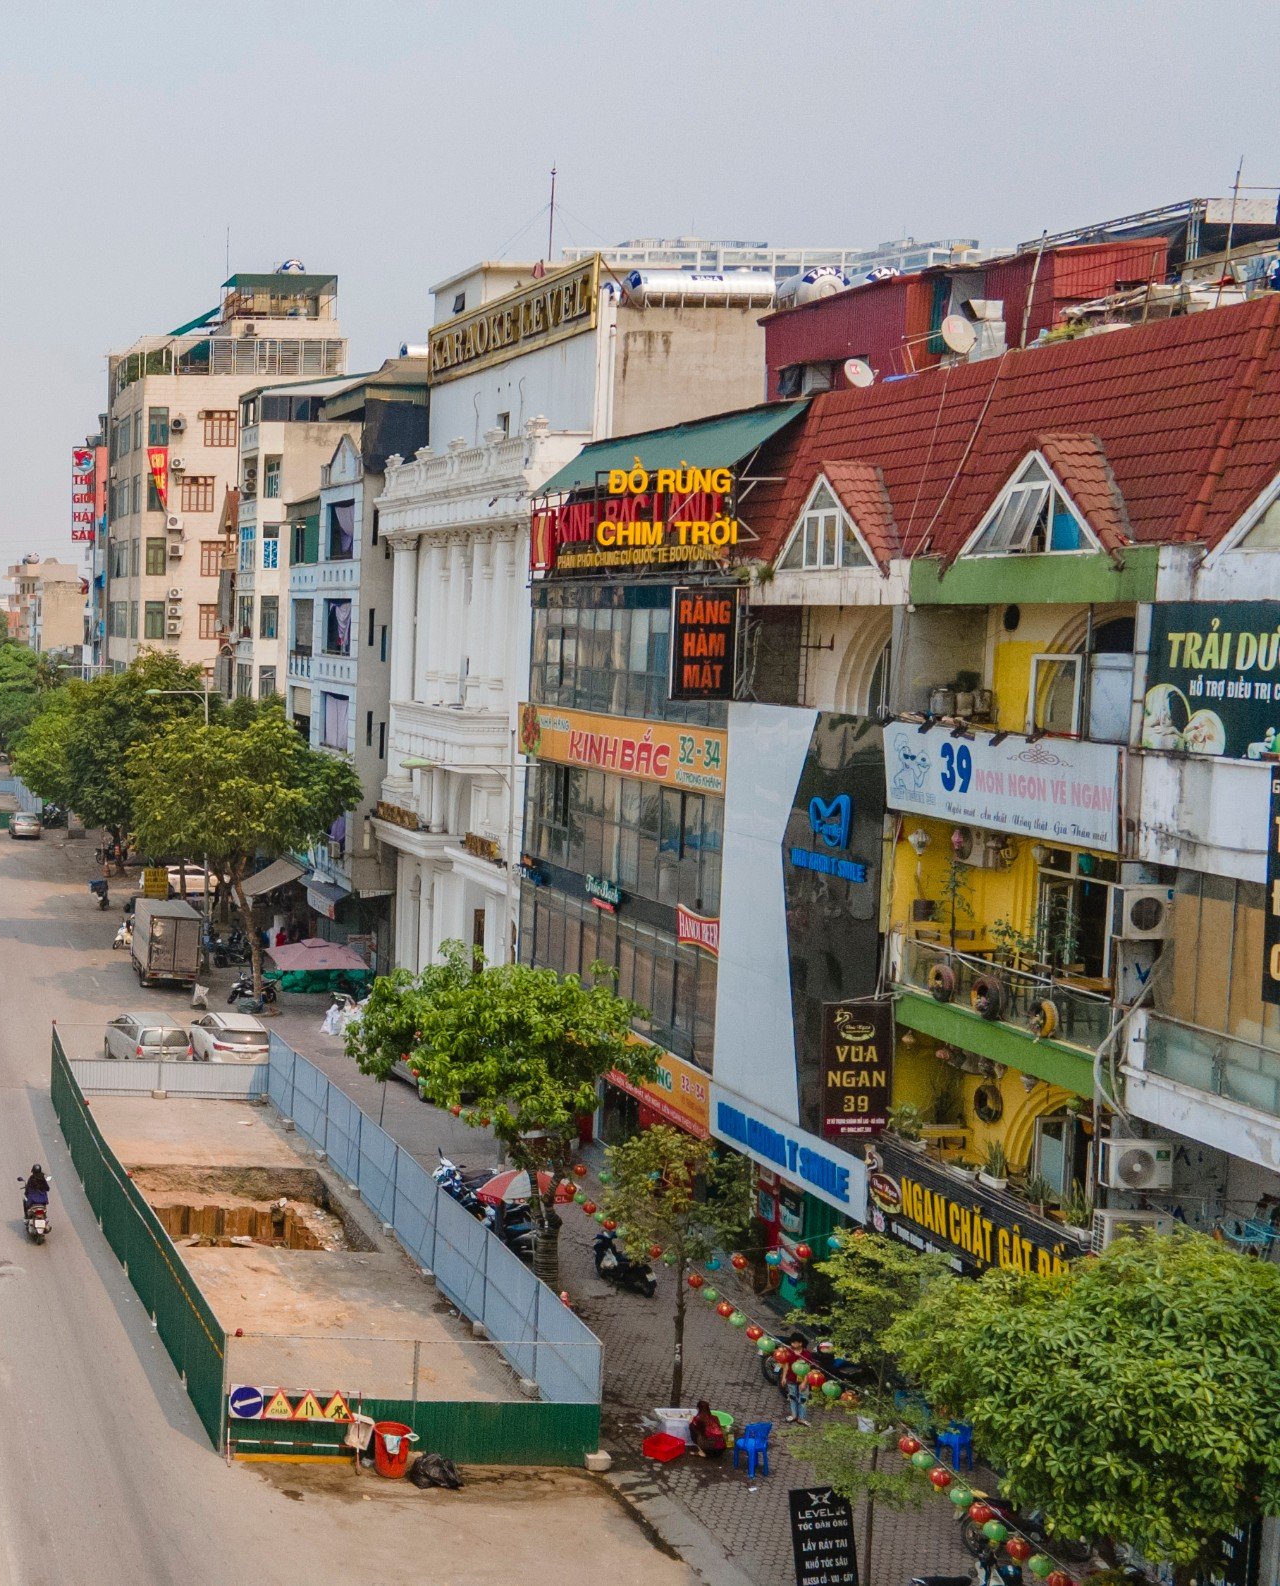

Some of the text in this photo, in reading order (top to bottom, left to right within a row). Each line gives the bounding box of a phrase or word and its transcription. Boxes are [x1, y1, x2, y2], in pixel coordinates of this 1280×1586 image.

[431, 274, 591, 372] KARAOKE LEVEL
[609, 456, 731, 494] ĐỒ RỪNG
[558, 501, 598, 543] KINH
[596, 513, 738, 546] CHIM TRỜI
[594, 551, 620, 566] CHUNG
[680, 595, 732, 624] RĂNG
[683, 628, 725, 657] HÀM
[1168, 617, 1232, 670] TRẢI
[683, 660, 723, 695] MẶT
[1206, 680, 1226, 701] TRỢ
[1254, 682, 1272, 704] TRỊ
[569, 727, 671, 779] KINH BẮC
[941, 742, 972, 793] 39
[1008, 773, 1047, 801] NGON
[1070, 781, 1113, 813] NGAN
[836, 1045, 879, 1063] VUA
[827, 1070, 887, 1088] NGAN
[843, 1095, 870, 1113] 39
[901, 1175, 947, 1238] NGAN
[949, 1202, 993, 1269] CHẶT
[798, 1508, 835, 1519] LEVEL
[835, 1539, 848, 1548] TAI
